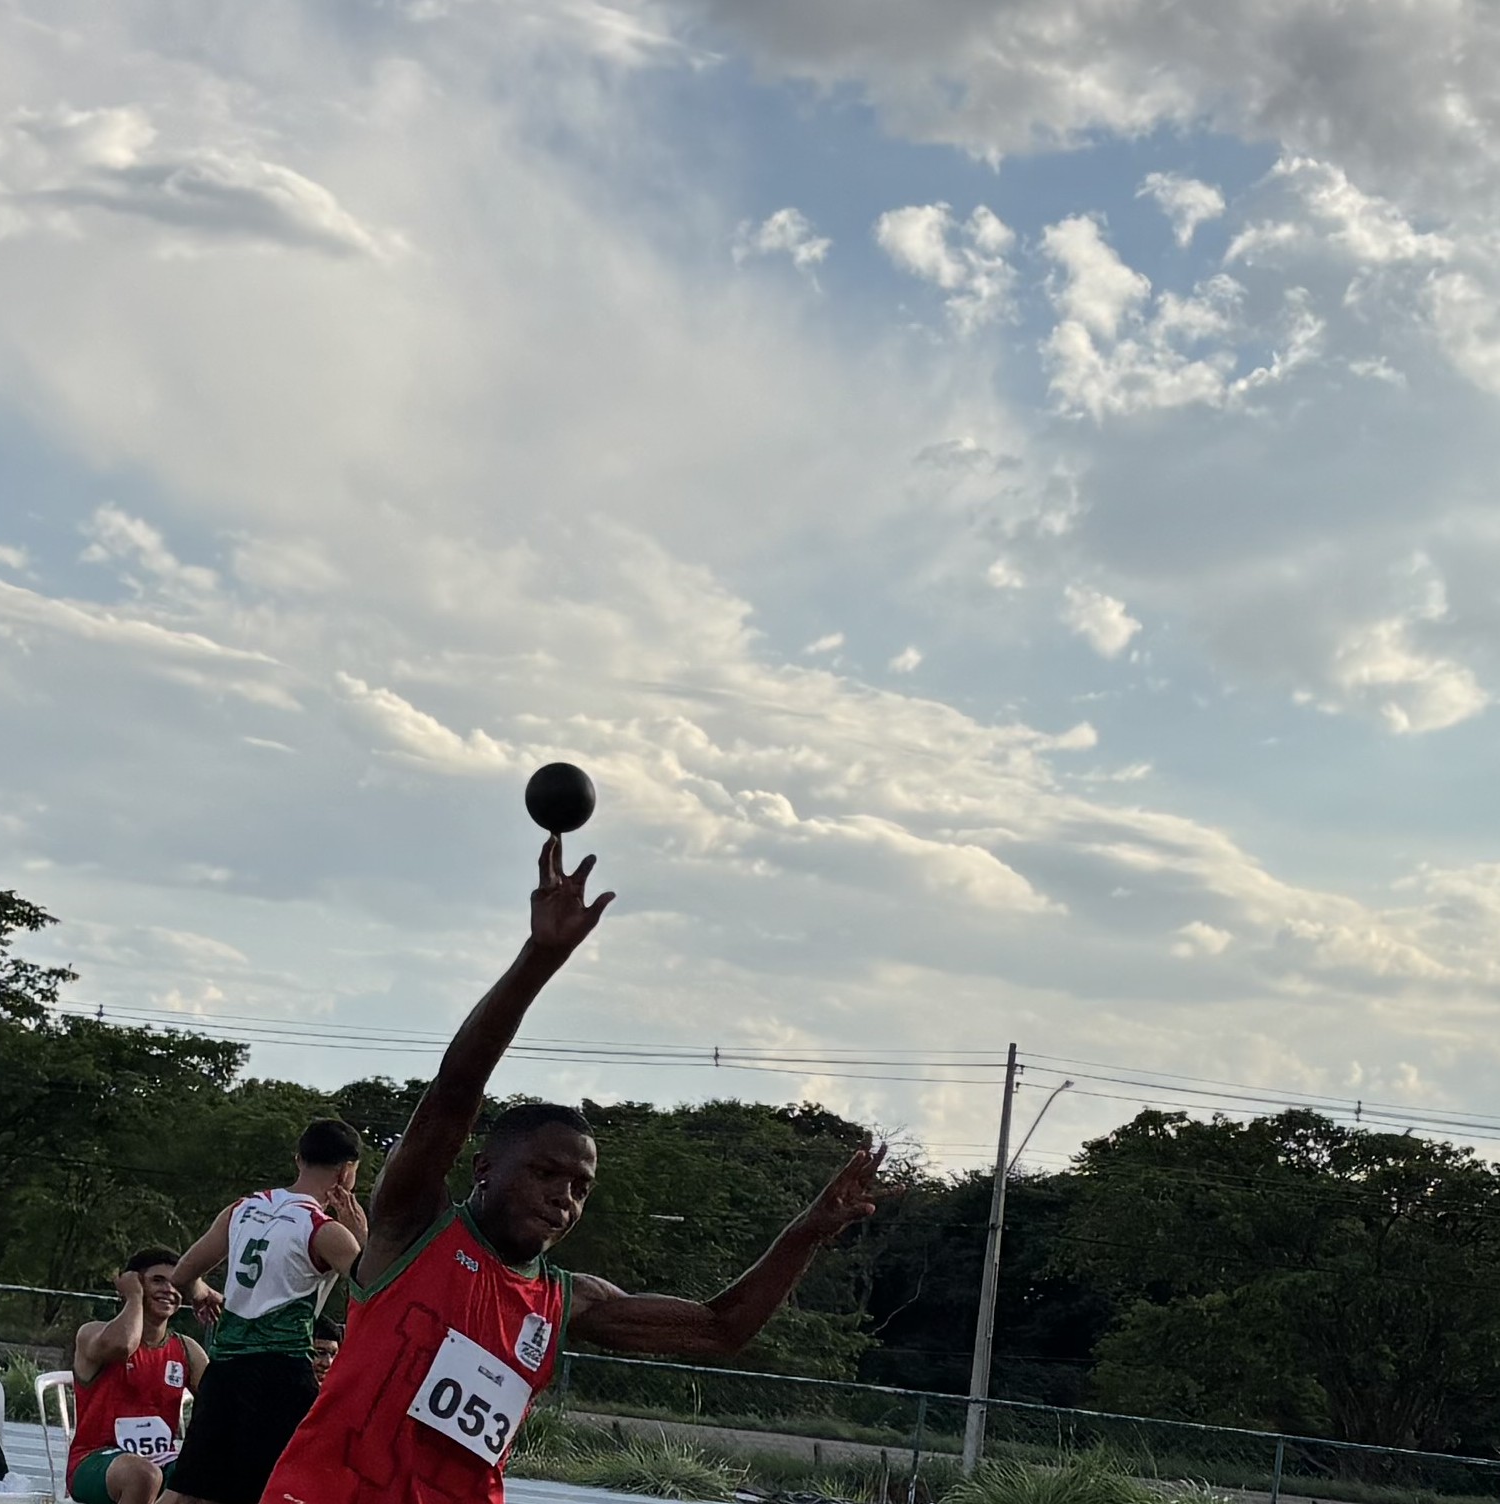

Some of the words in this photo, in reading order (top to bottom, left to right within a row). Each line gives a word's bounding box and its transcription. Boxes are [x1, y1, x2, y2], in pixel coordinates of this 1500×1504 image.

[236, 1238, 270, 1289] 5
[428, 1377, 510, 1455] 053
[124, 1437, 168, 1455] 056
